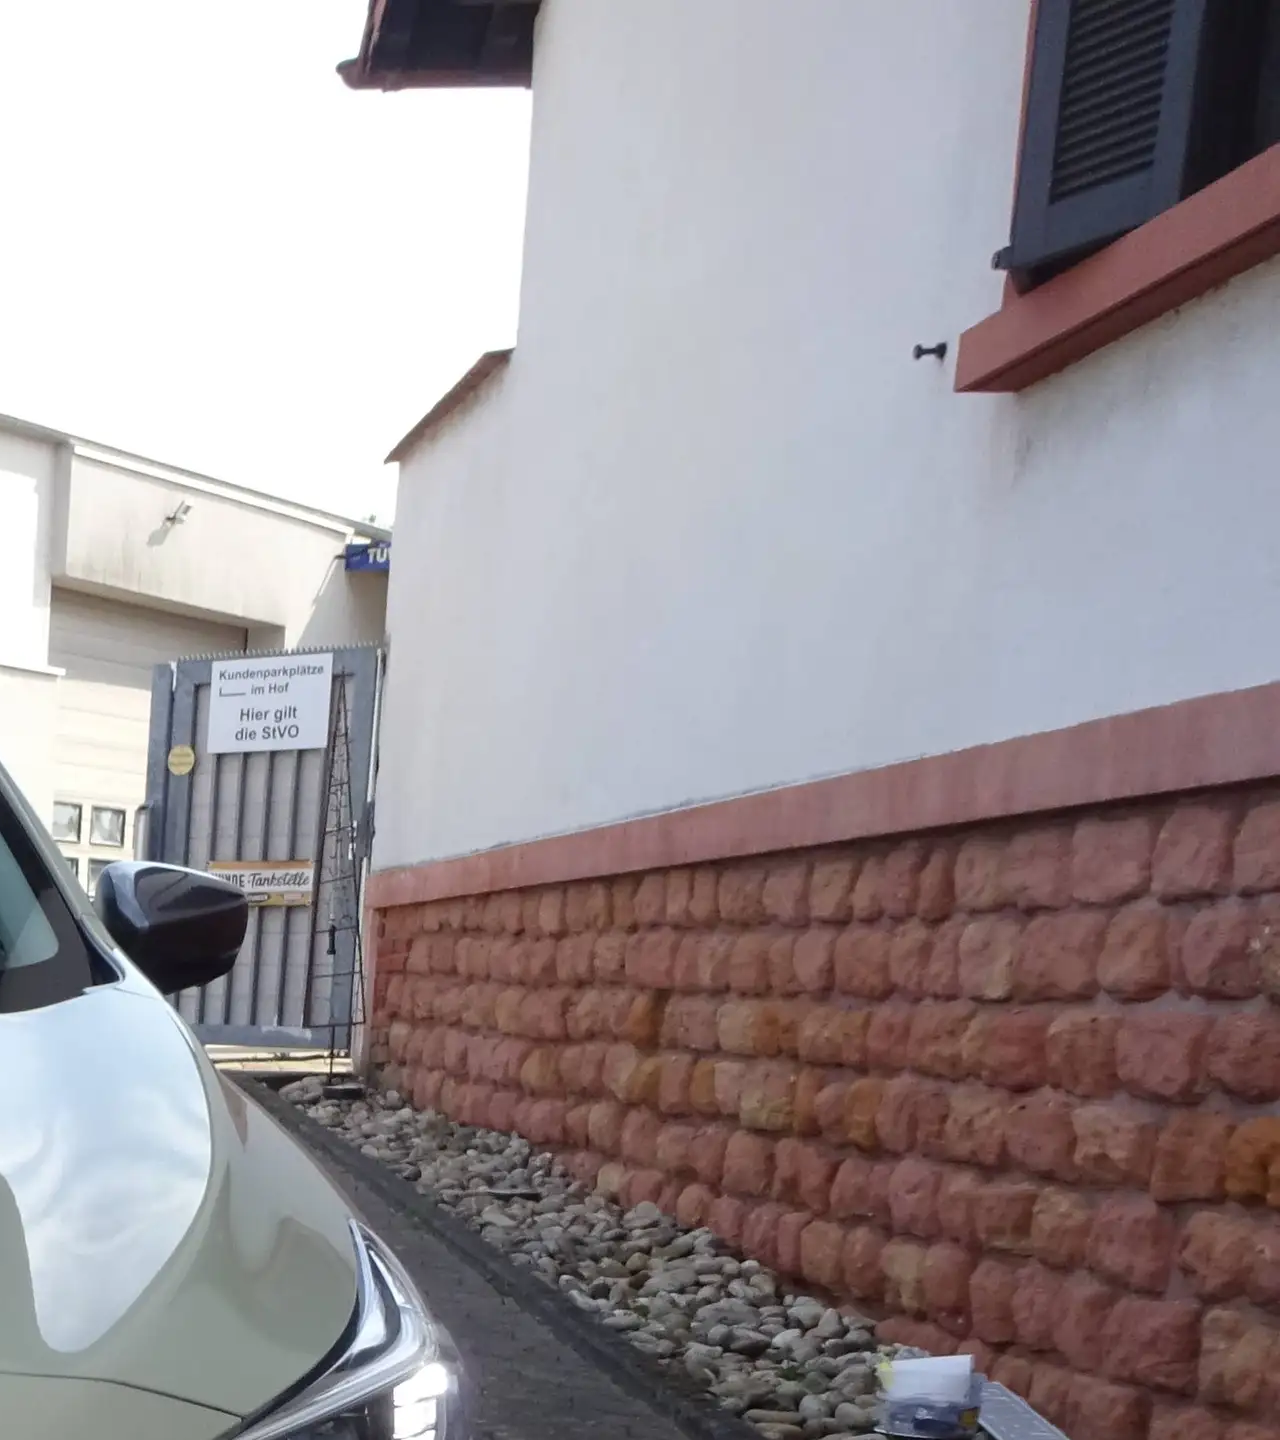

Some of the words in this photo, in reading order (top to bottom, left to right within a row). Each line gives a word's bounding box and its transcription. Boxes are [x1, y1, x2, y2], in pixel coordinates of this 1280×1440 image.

[219, 665, 324, 680] Kundenparkplätze
[251, 685, 265, 695] im
[268, 682, 289, 694] Hof
[240, 708, 270, 721] Hier
[274, 705, 297, 723] gilt
[235, 728, 257, 741] die
[261, 724, 299, 740] StVO
